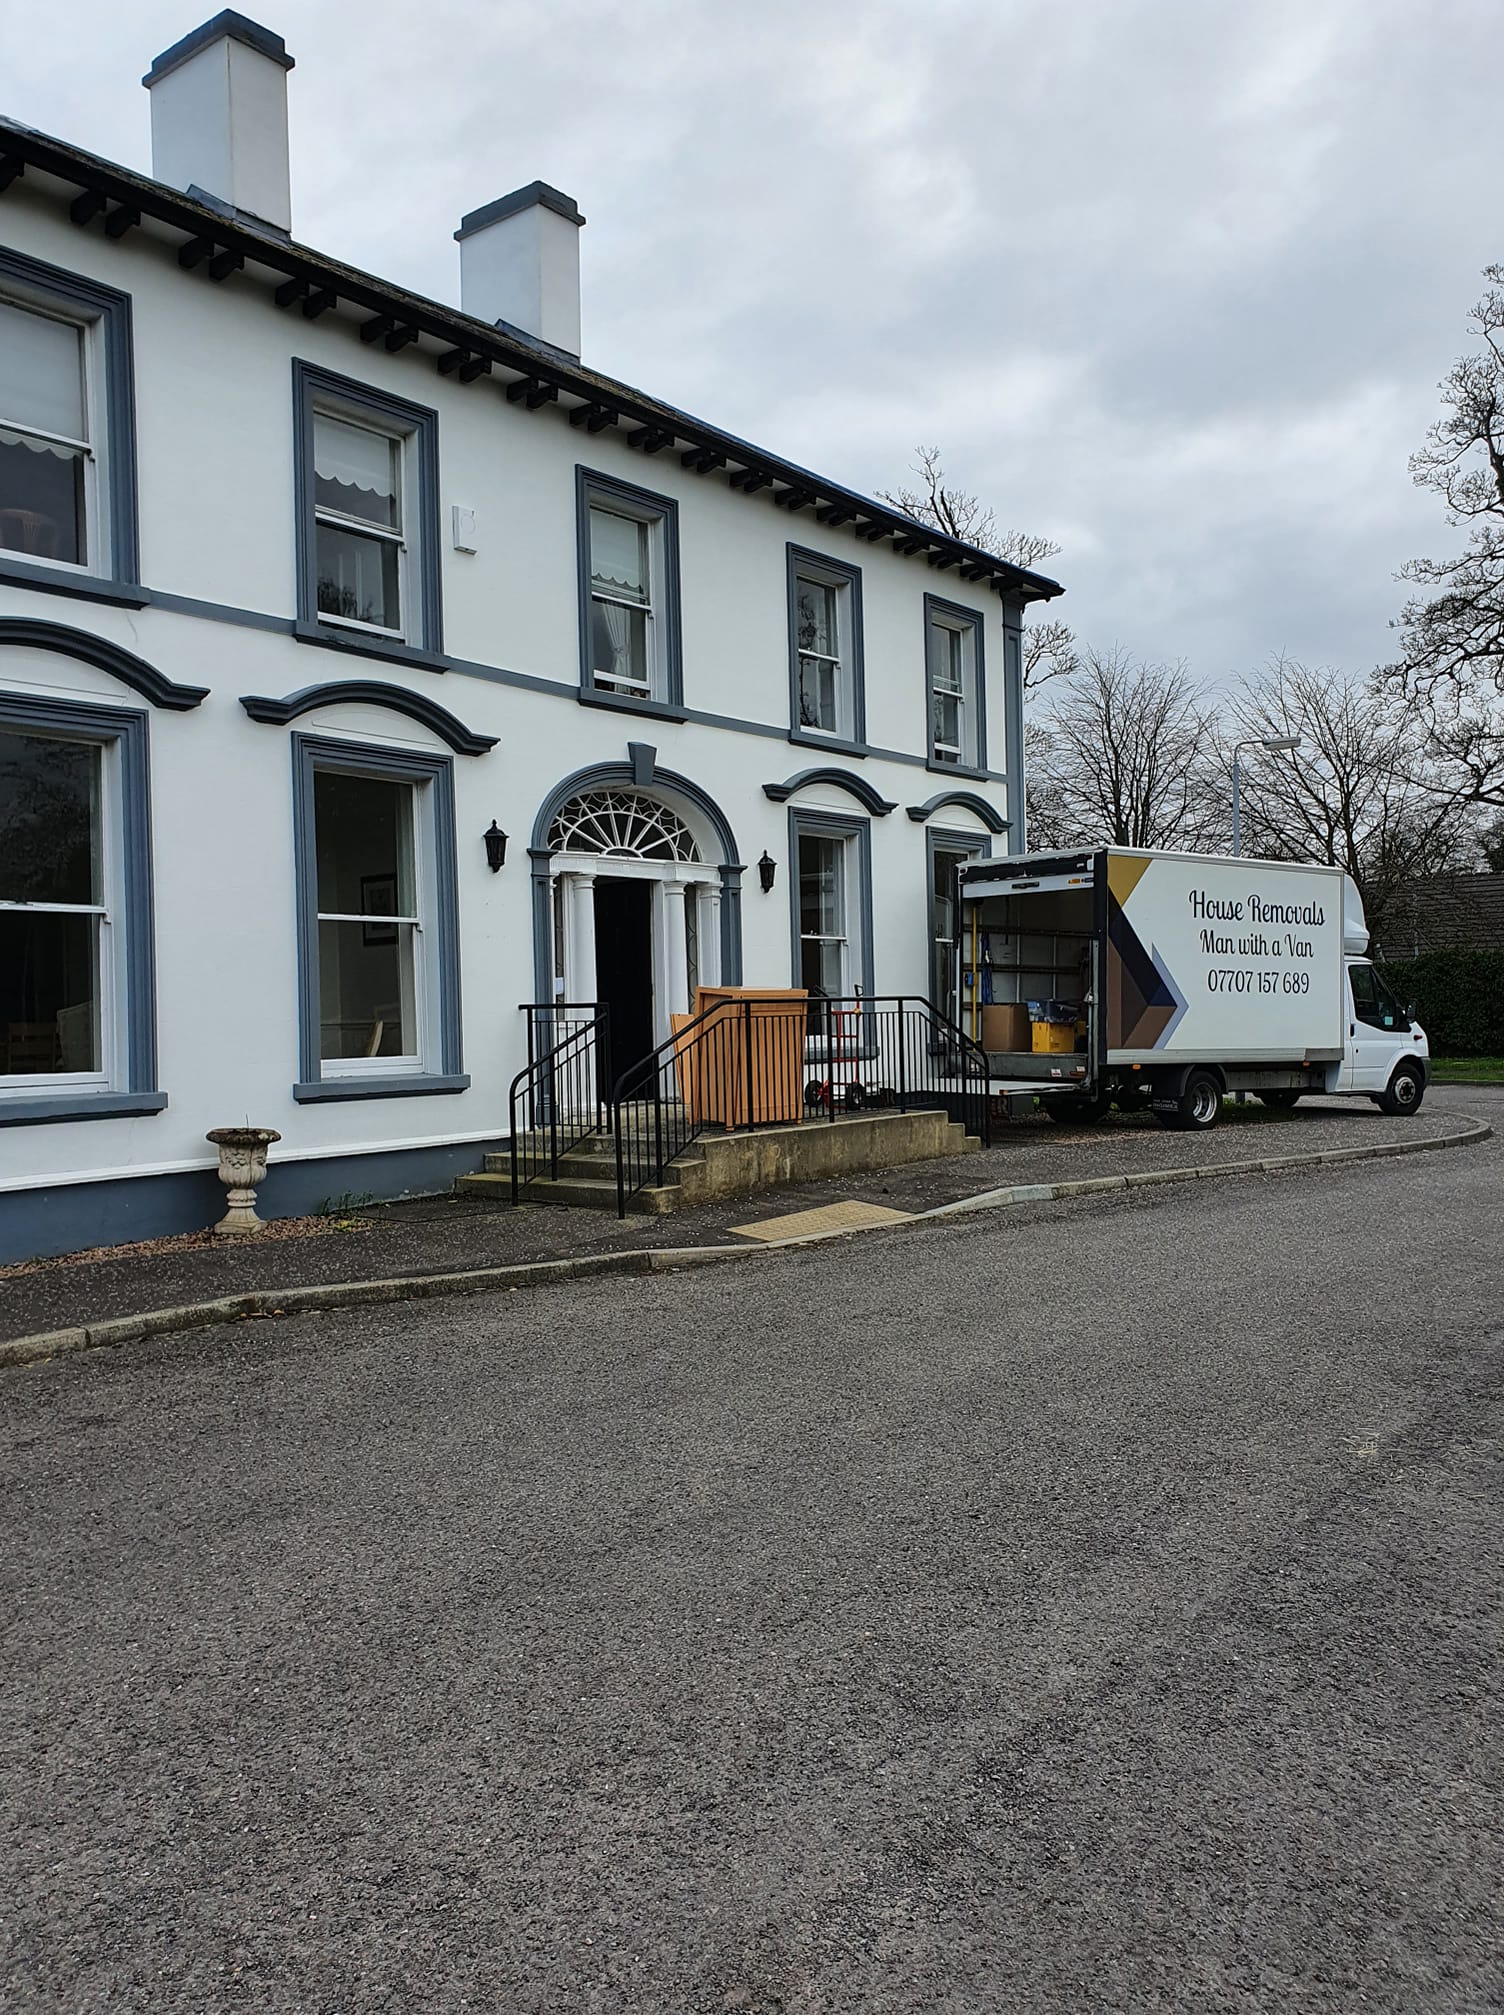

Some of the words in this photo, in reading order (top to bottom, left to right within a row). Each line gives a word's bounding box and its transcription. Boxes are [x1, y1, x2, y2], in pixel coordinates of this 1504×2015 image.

[1188, 890, 1244, 922] House
[1247, 894, 1326, 926] Removals
[1199, 928, 1235, 955] Man
[1238, 933, 1268, 956] with
[1272, 940, 1282, 957] a
[1284, 933, 1314, 958] Van
[1207, 969, 1254, 993] 07707
[1257, 972, 1279, 993] 157
[1282, 971, 1309, 994] 689
